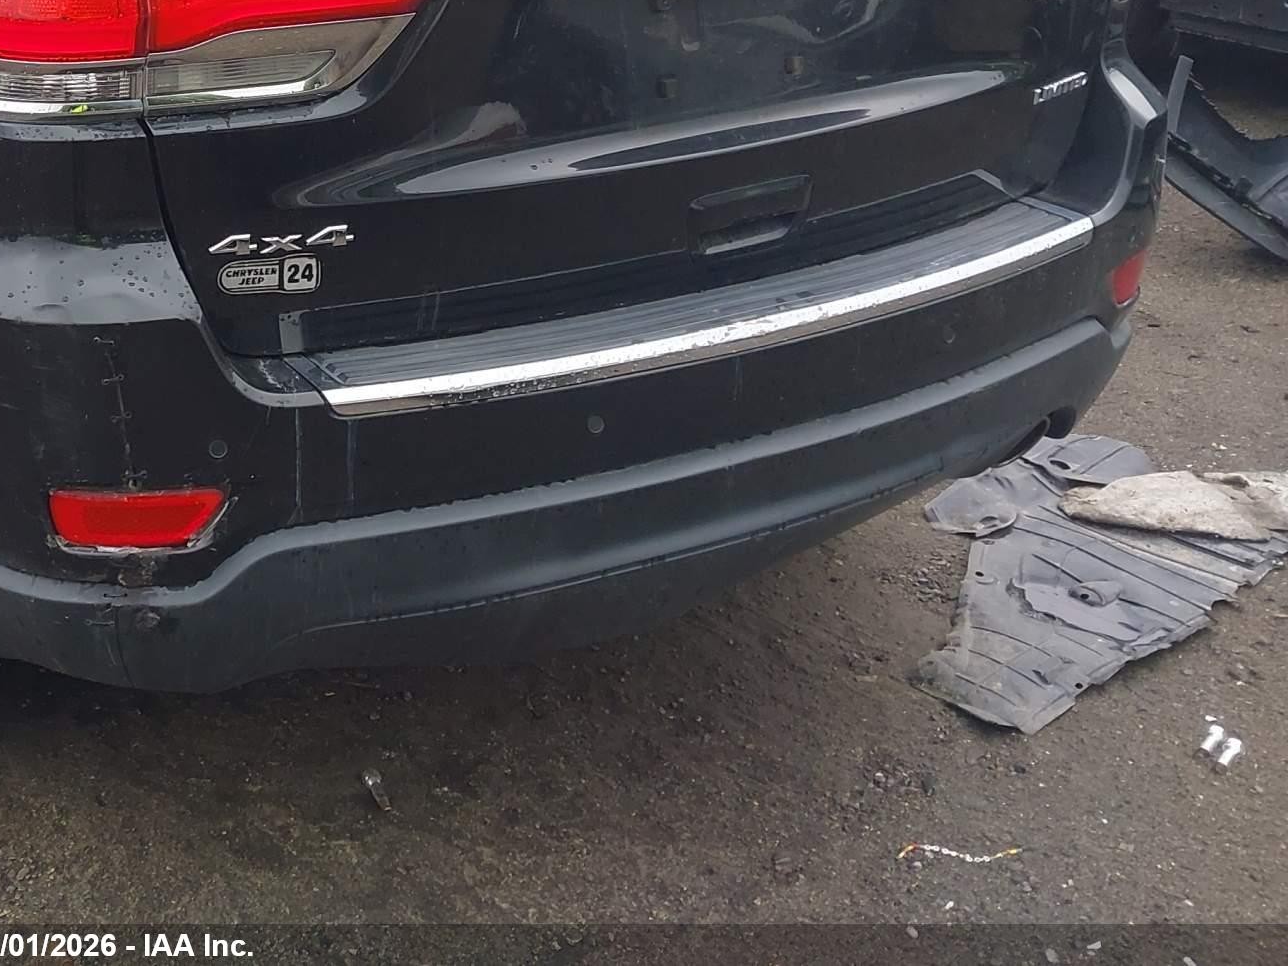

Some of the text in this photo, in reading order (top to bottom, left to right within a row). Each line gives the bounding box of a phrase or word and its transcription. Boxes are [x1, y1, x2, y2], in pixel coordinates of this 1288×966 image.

[225, 266, 278, 278] CHRYSLER
[287, 264, 314, 284] 24
[238, 277, 266, 286] JEEP
